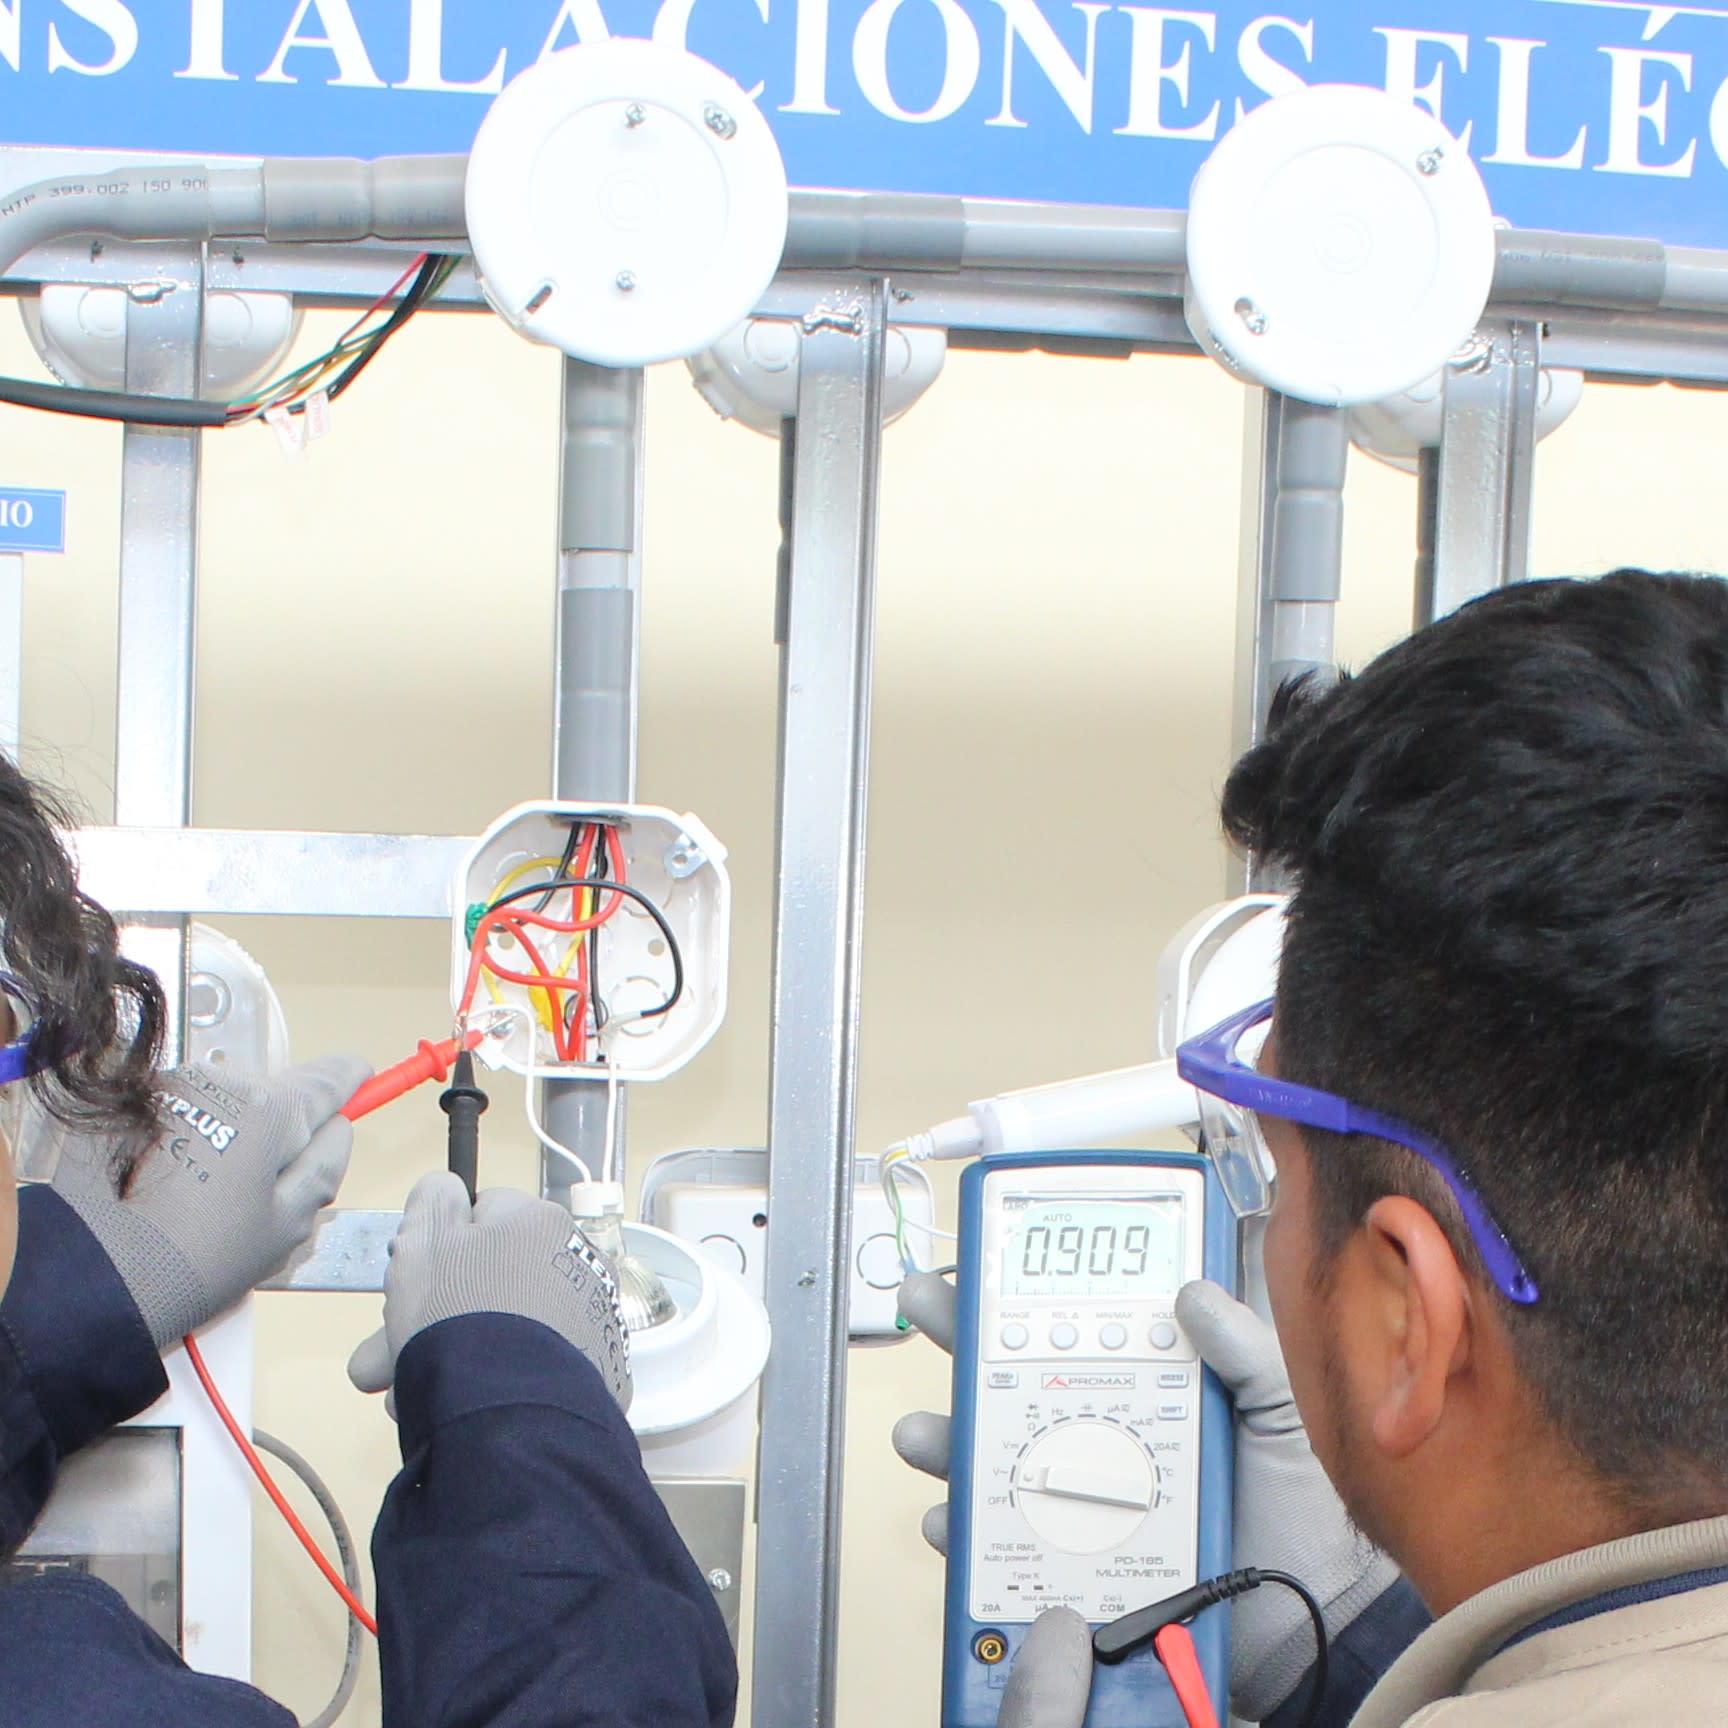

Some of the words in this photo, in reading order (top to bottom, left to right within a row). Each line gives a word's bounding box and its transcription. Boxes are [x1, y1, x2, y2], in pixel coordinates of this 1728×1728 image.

[1043, 1213, 1073, 1223] AUTO
[1022, 1226, 1150, 1276] 0.909
[1068, 1377, 1133, 1386] PROMAX
[988, 1496, 1008, 1505] OFF
[991, 1543, 1014, 1551] TRUE
[1016, 1543, 1036, 1551] RMS
[983, 1553, 1003, 1562] Auto
[1004, 1554, 1029, 1563] power
[1031, 1553, 1043, 1562] off
[1114, 1556, 1164, 1565] PD-185
[1012, 1572, 1031, 1582] Type
[1095, 1569, 1181, 1578] MULTIMETER
[981, 1603, 1001, 1613] 20A
[1099, 1603, 1126, 1613] COM
